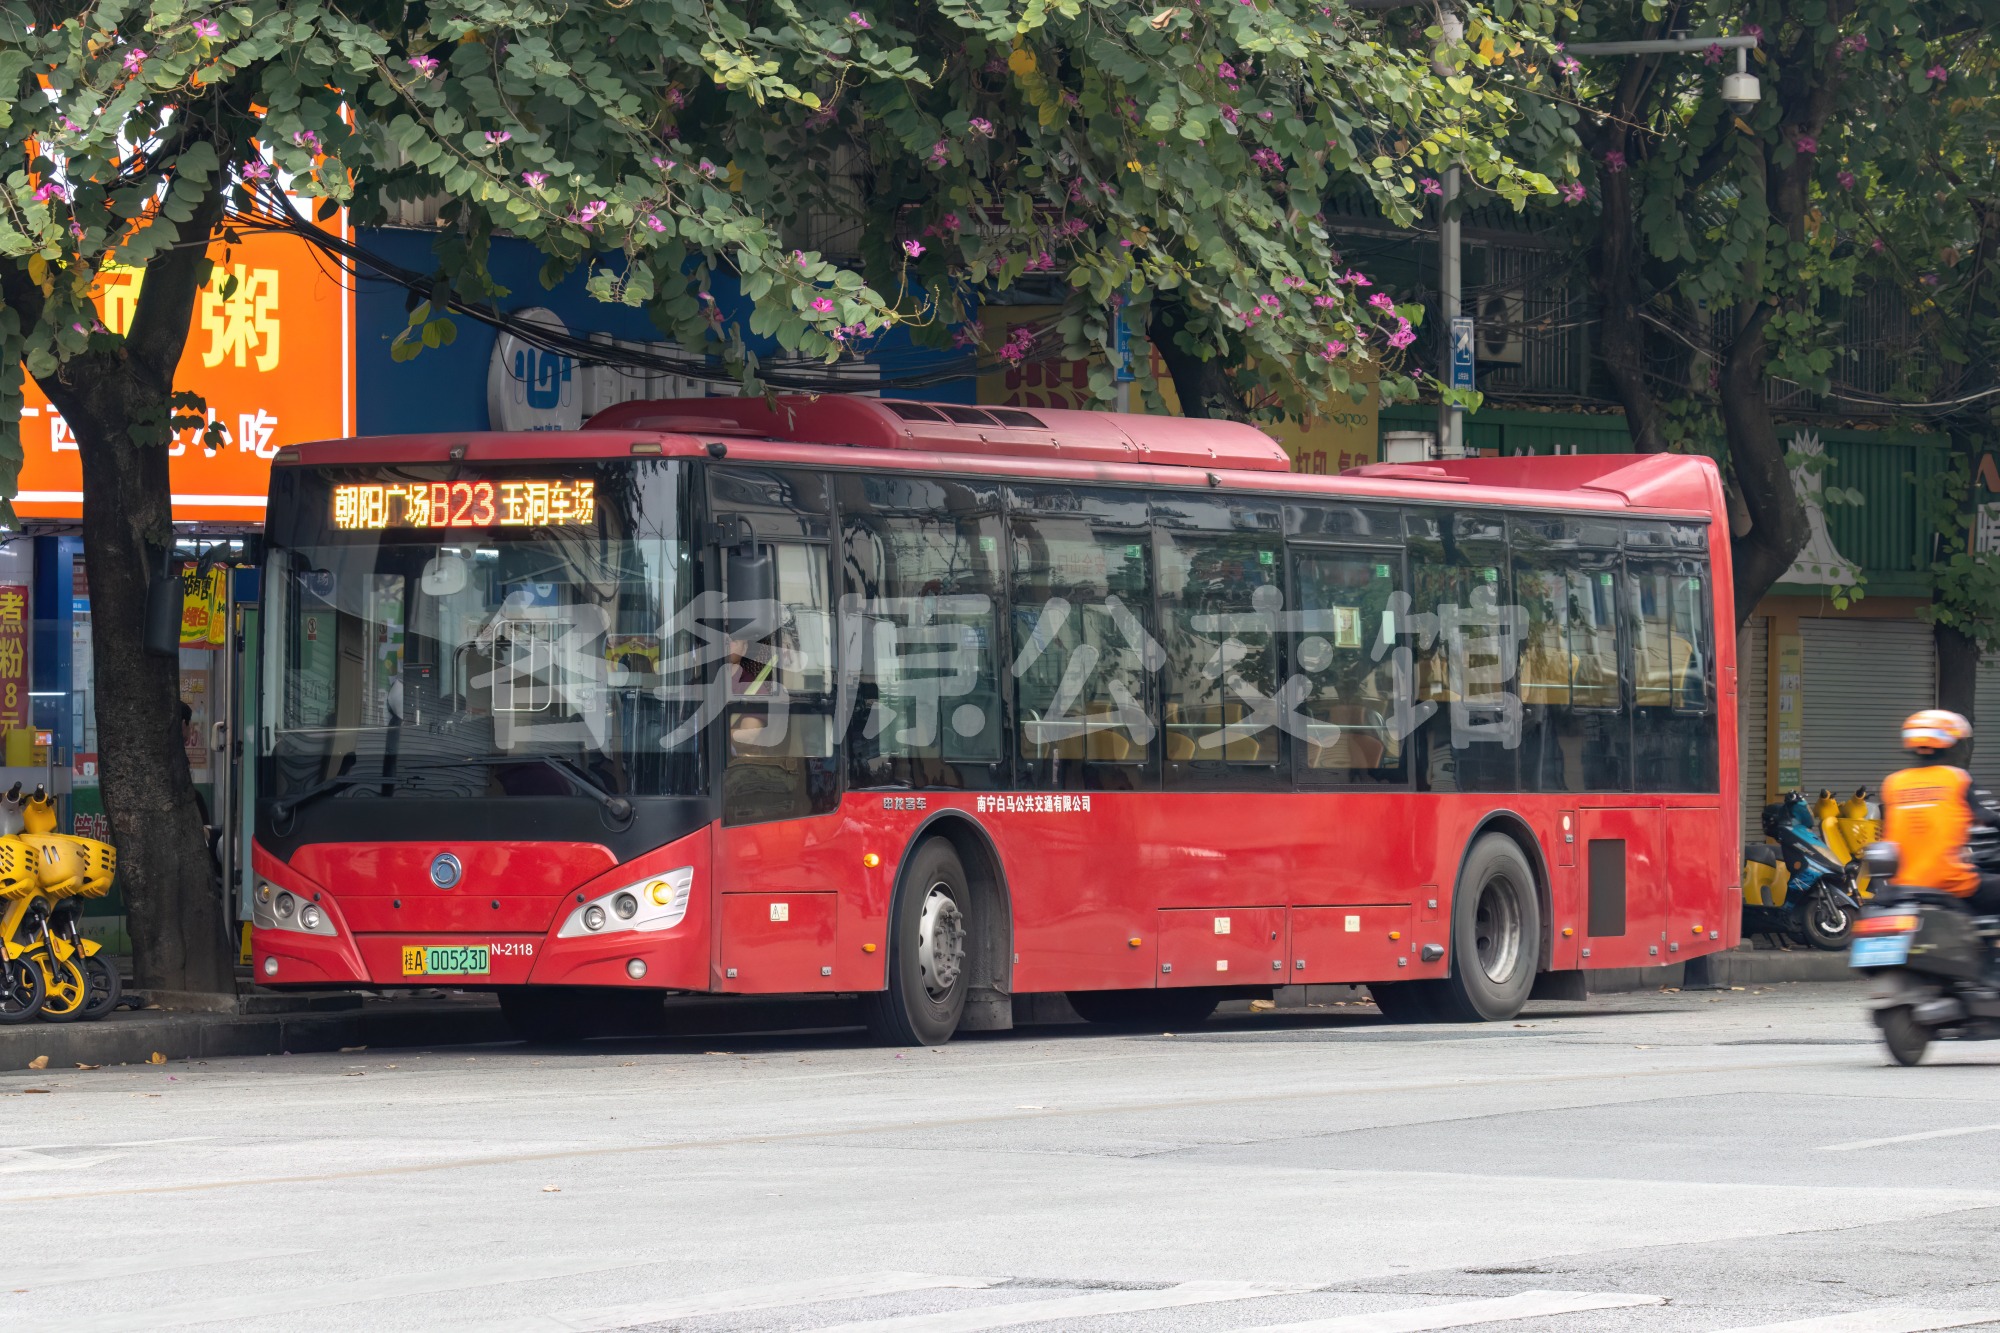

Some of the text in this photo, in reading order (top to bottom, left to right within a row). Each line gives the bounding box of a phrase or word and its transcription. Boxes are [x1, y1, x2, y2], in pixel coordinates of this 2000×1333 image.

[334, 481, 595, 529] 朝阳广场 B23 玉洞车场
[976, 795, 1091, 813] 南宁白马公共交通有限公司
[491, 943, 533, 956] N-2118
